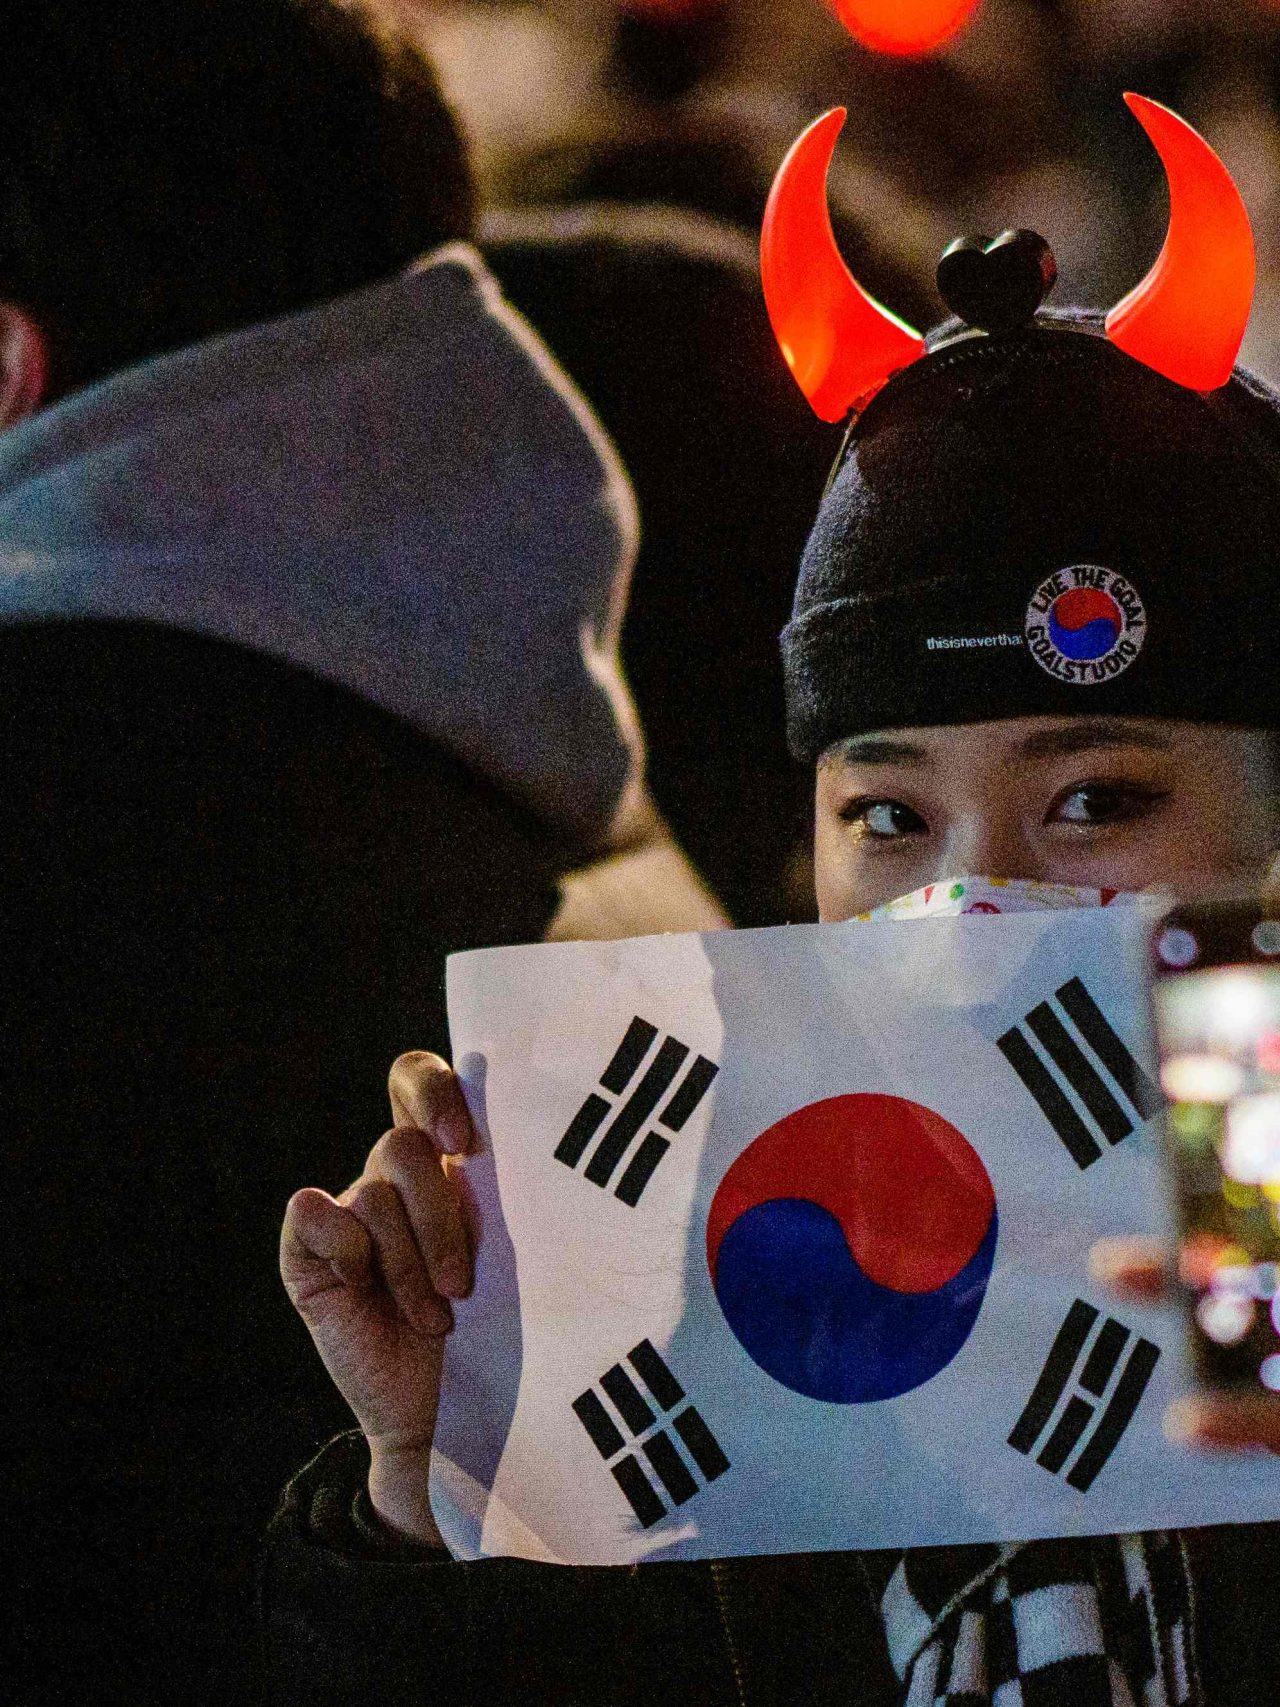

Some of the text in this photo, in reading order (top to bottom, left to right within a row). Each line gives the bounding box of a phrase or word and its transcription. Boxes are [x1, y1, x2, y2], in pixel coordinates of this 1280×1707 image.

[1031, 568, 1145, 631] LIVE THE GOAL
[1027, 625, 1138, 681] GOALSTUDIO
